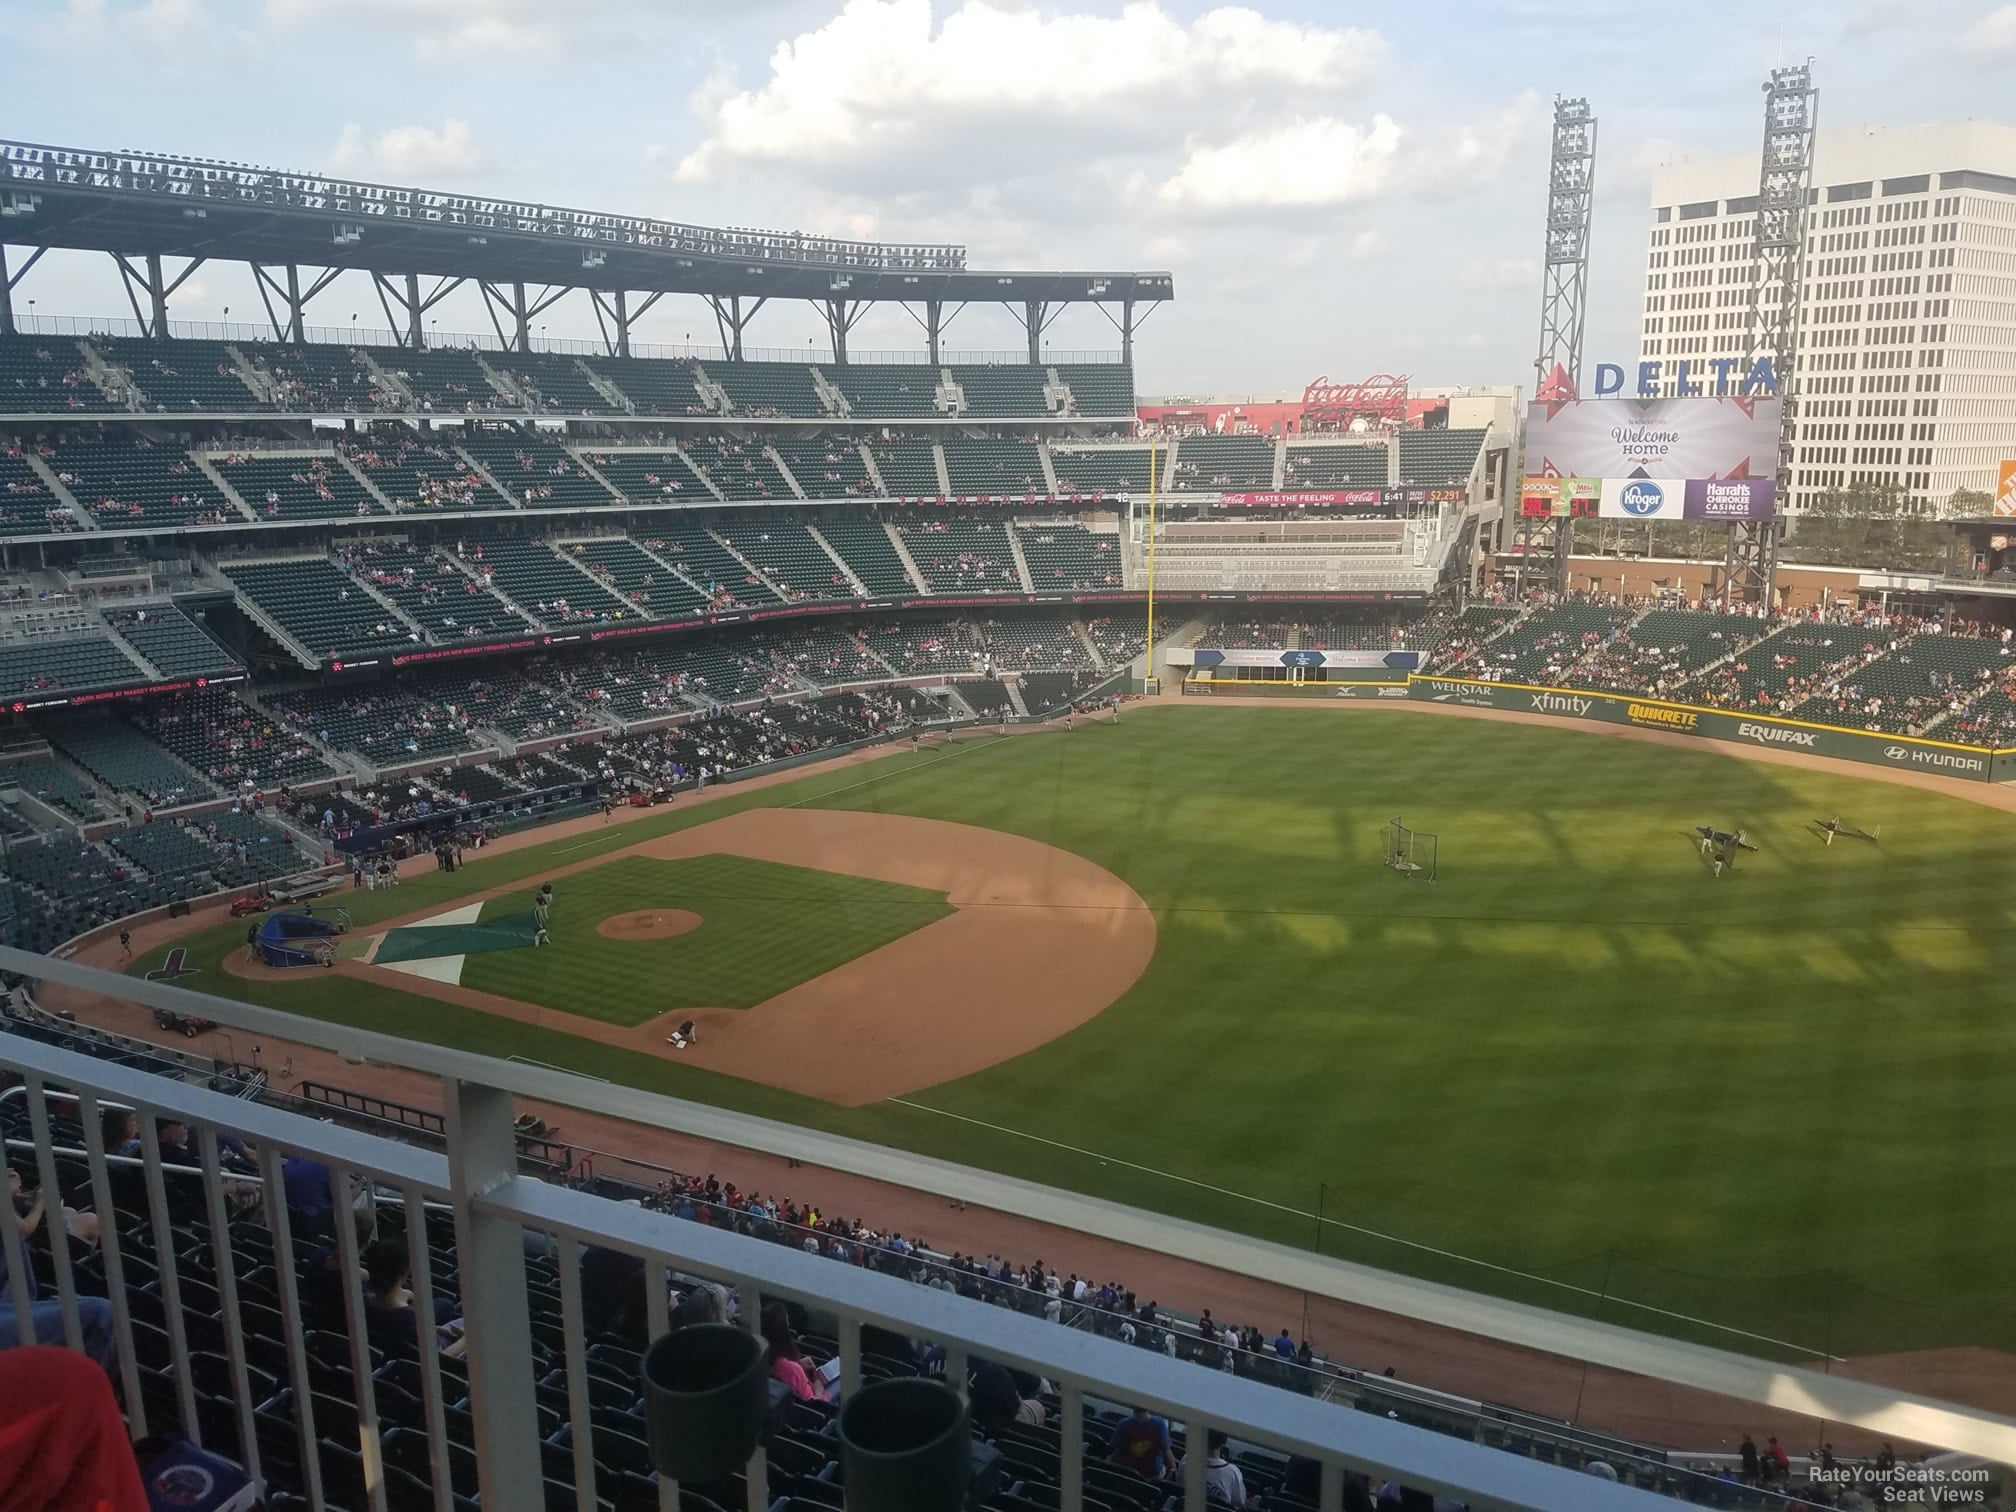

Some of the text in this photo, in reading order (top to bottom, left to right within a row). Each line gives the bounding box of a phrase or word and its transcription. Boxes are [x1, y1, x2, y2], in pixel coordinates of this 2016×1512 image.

[1594, 357, 1778, 396] DELTA
[1611, 425, 1680, 444] Welcome
[1384, 492, 1403, 501] 6:41
[1706, 483, 1751, 496] Harrah's
[1116, 492, 1129, 503] 42
[1300, 494, 1335, 502] FEELING
[1624, 486, 1661, 513] Kroger
[1706, 496, 1750, 504] CHEROKEE
[1705, 503, 1750, 512] CASINOS
[96, 691, 114, 699] MORE
[1432, 682, 1492, 696] WELLSTAR
[1531, 692, 1593, 716] xfinity
[1628, 703, 1698, 726] QUIKRETE
[1738, 722, 1816, 746] EQUIFAX
[1912, 751, 1983, 772] HYUNDAI
